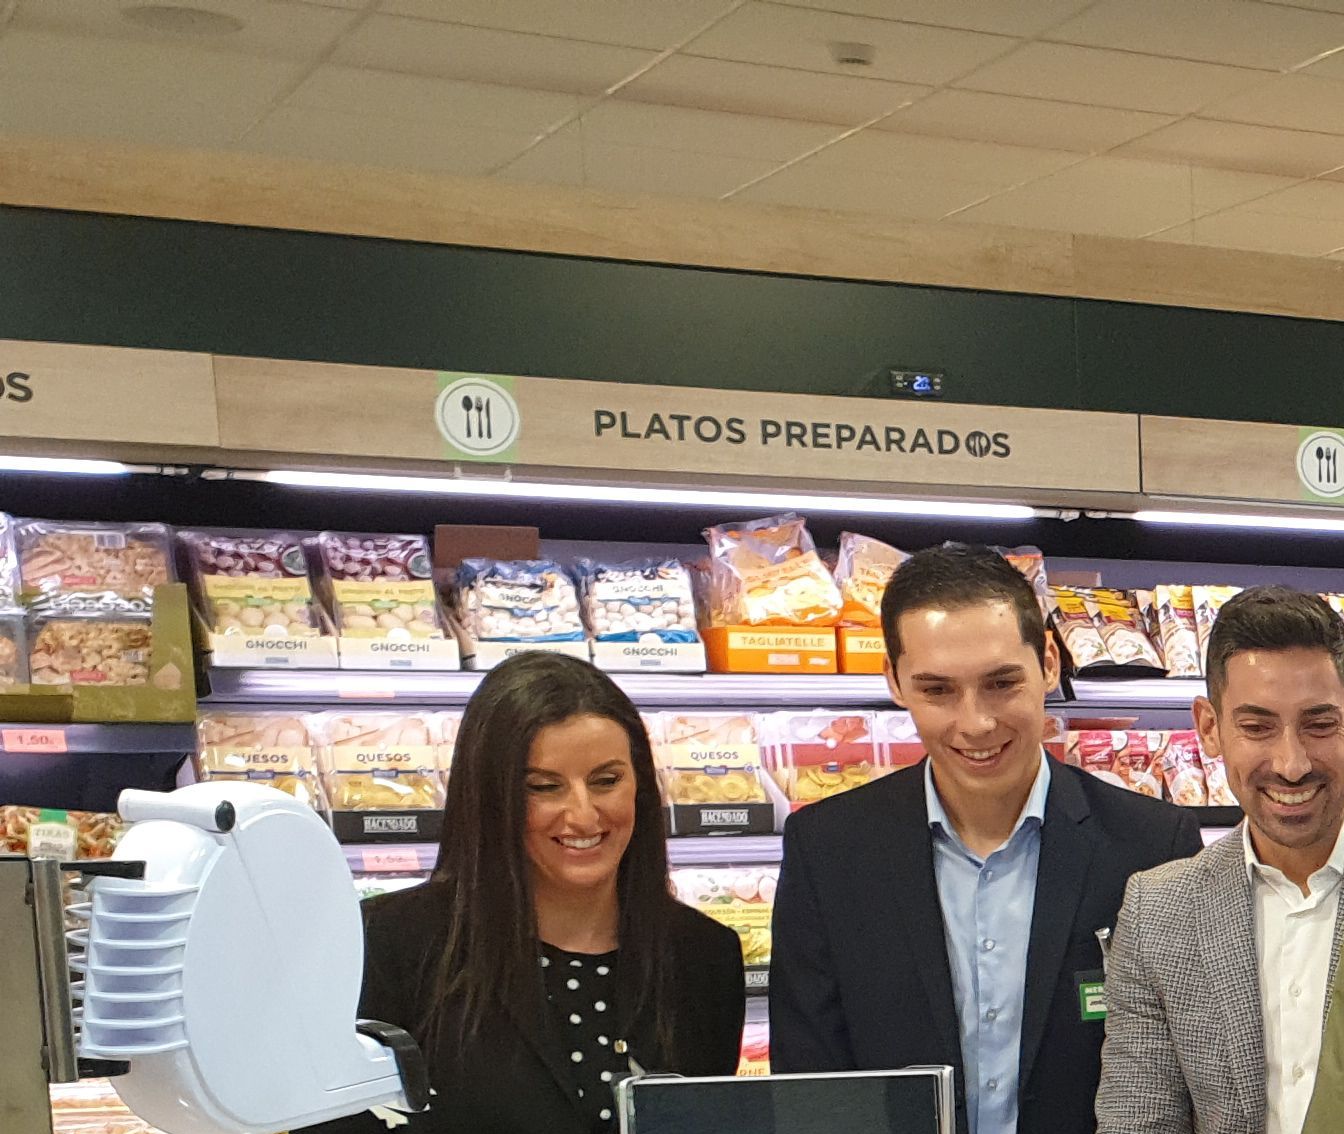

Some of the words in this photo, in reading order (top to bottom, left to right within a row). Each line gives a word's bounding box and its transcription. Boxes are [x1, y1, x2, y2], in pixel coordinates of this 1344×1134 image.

[0, 371, 34, 403] S
[593, 410, 746, 445] PLATOS
[761, 419, 1012, 459] PREPARADOS
[246, 640, 308, 650] GNOCCHI
[741, 636, 826, 648] TAGLIATELLE
[371, 643, 431, 653] GNOCCHI
[623, 648, 678, 657] GNOCCHI
[356, 753, 412, 764] QUESOS
[690, 751, 740, 761] QUESOS
